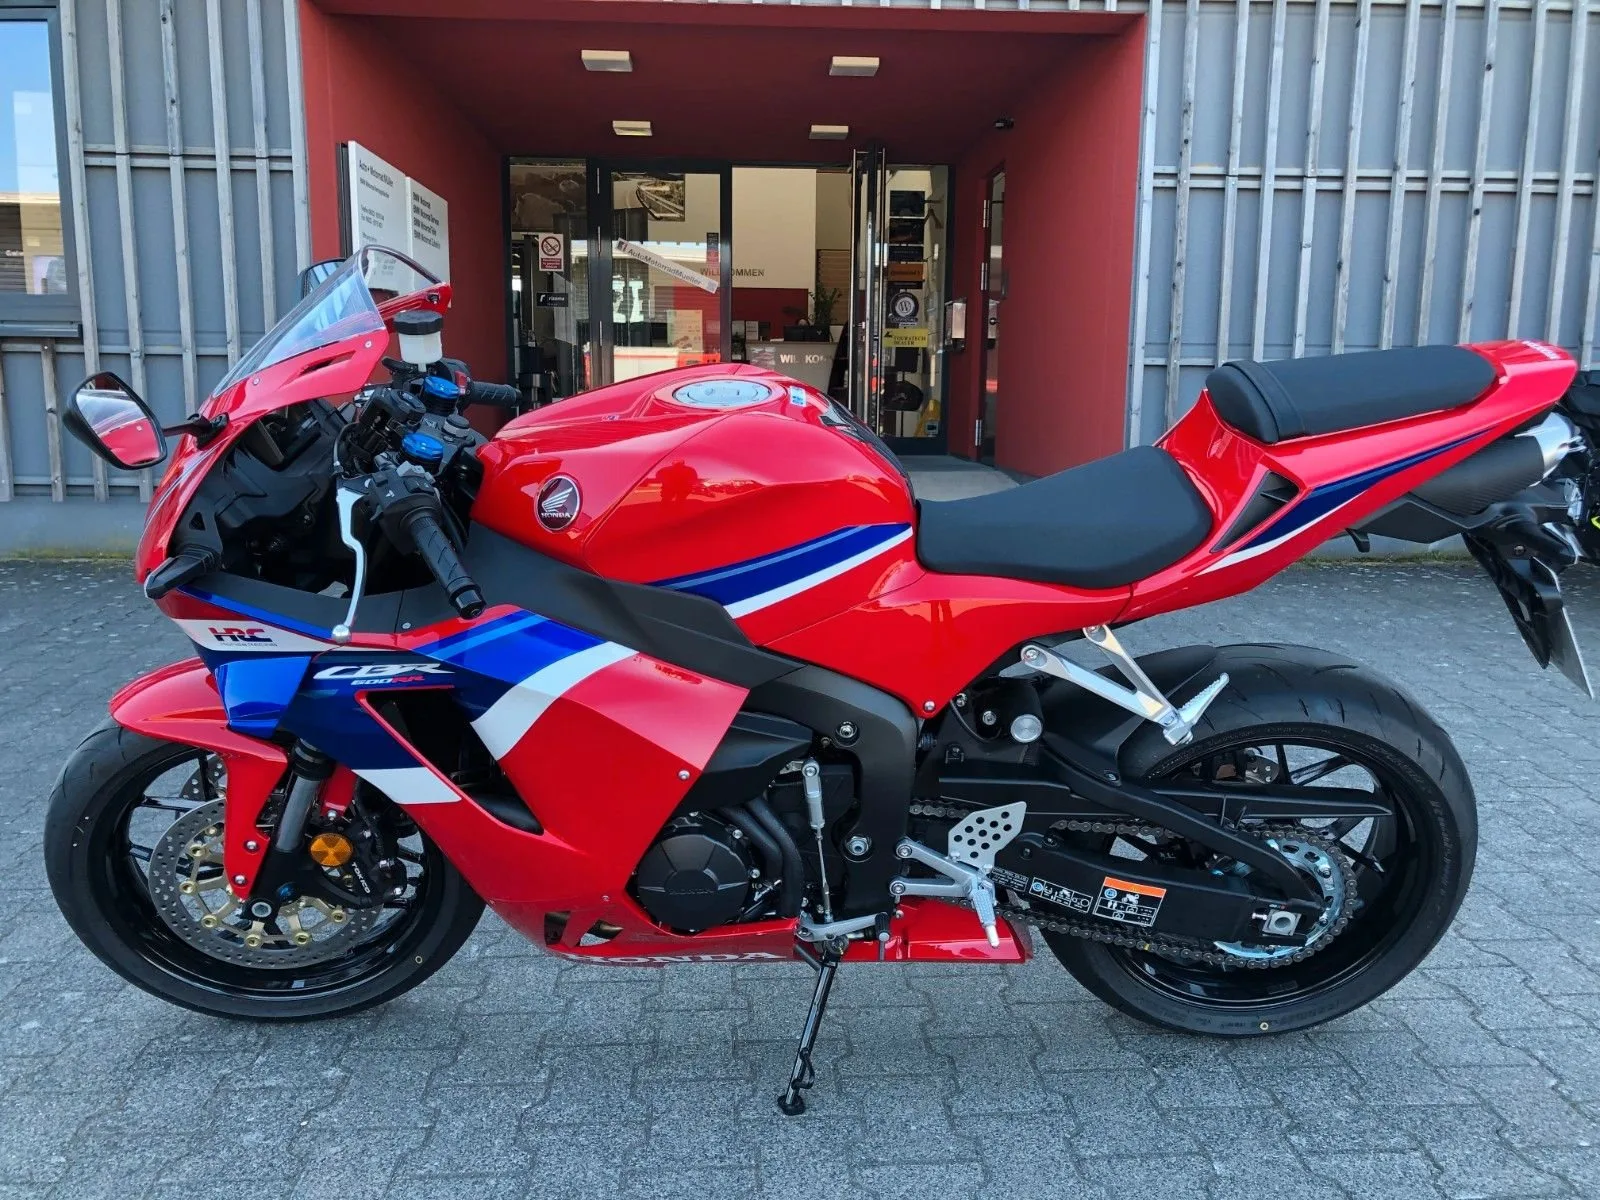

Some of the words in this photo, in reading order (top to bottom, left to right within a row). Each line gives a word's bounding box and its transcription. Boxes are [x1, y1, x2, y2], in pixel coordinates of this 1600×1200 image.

[627, 248, 703, 286] AutoMotorradMueller
[701, 268, 765, 277] WILLOMMEN
[208, 627, 273, 642] HRC
[312, 663, 455, 679] CBR
[351, 862, 371, 894] TOKICO
